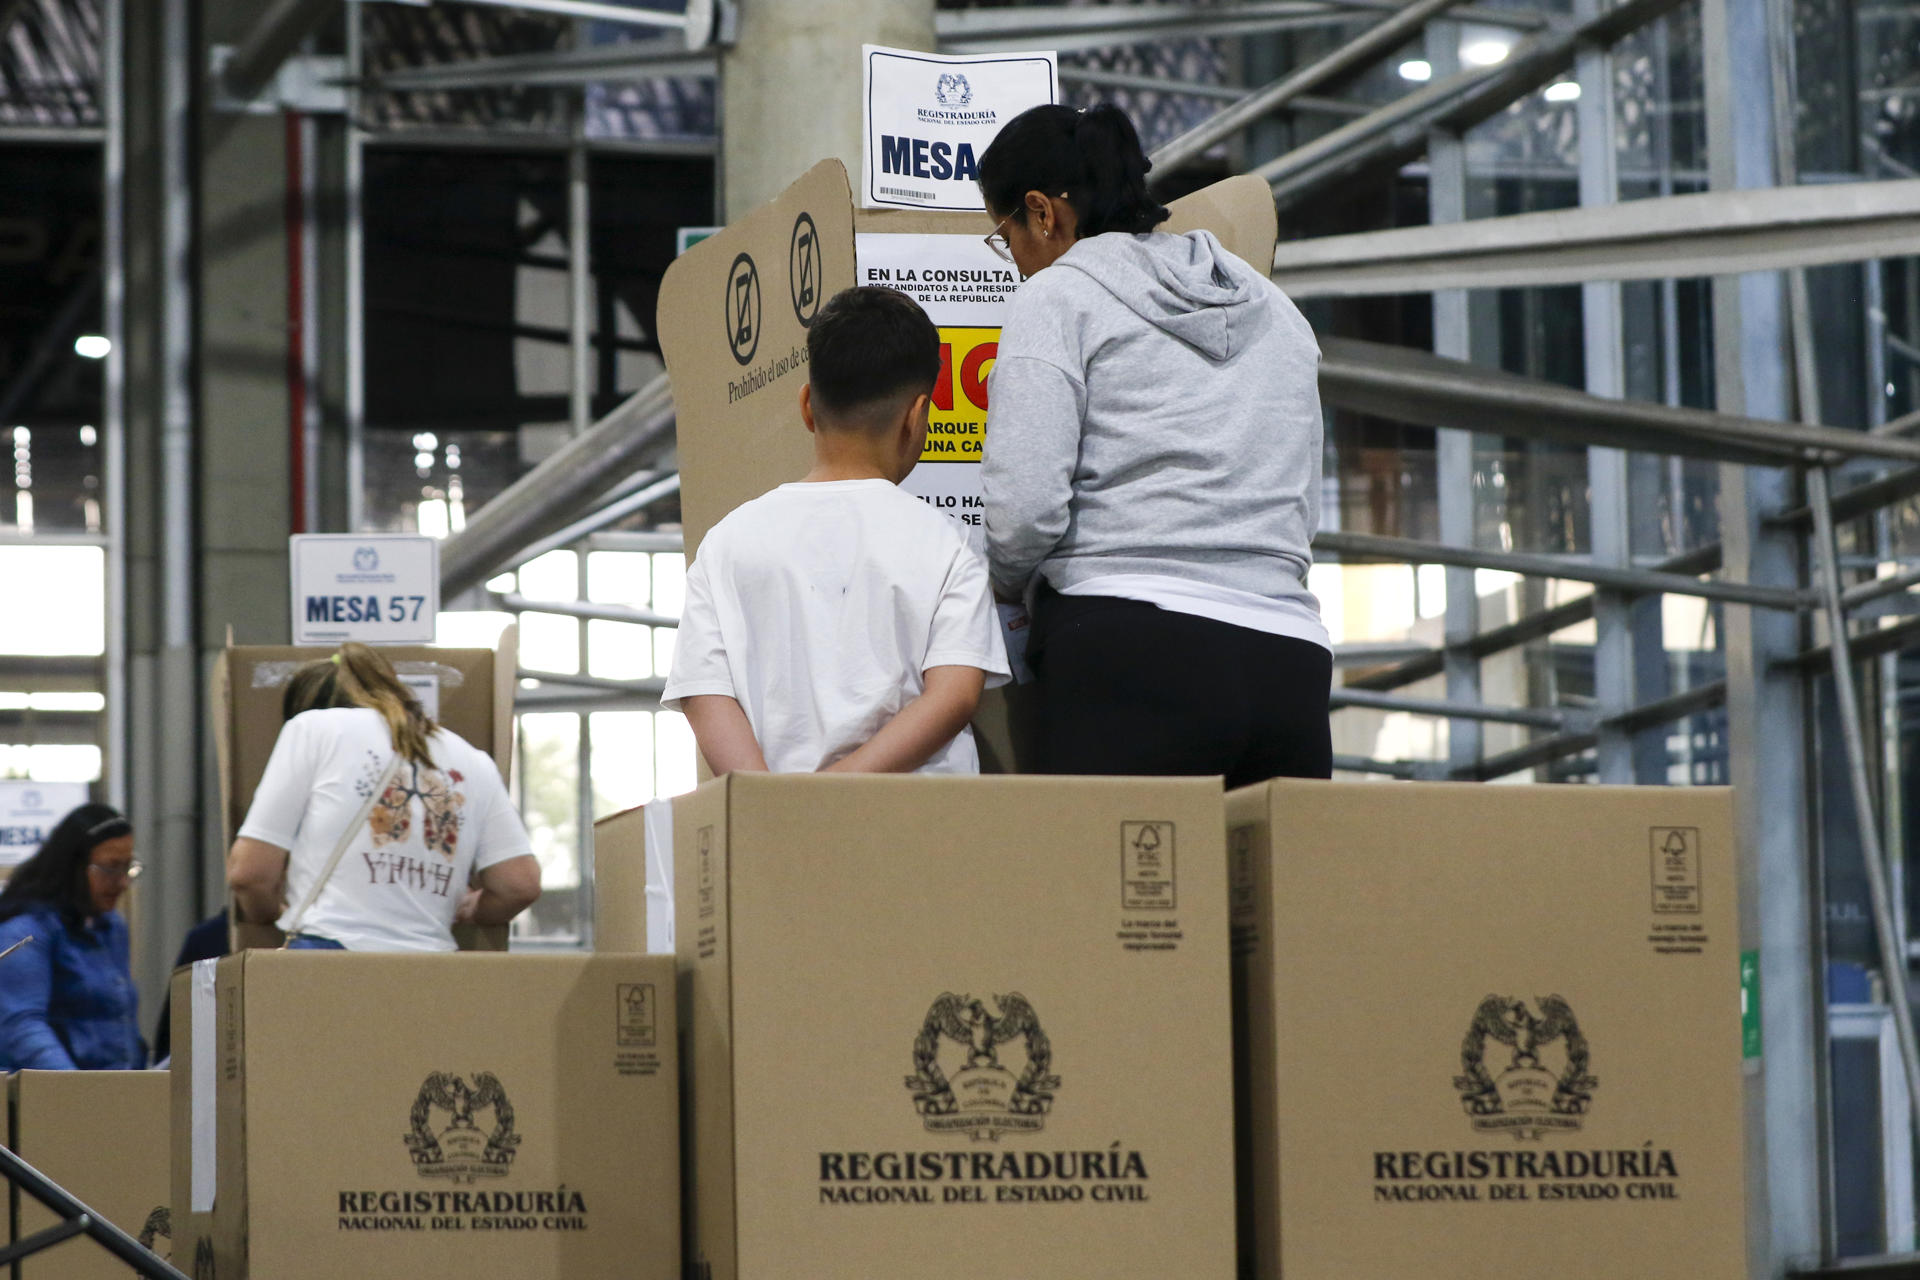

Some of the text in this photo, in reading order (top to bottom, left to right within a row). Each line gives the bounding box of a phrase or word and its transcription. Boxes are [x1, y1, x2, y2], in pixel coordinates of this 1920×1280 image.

[917, 108, 997, 120] REGISTRADURÍA
[881, 135, 978, 181] MESA
[868, 268, 890, 281] EN
[896, 269, 917, 281] LA
[922, 270, 1014, 283] CONSULTA
[976, 285, 1019, 293] PRESIDE
[918, 293, 1005, 303] DE LA REPÚBLICA
[728, 366, 767, 404] Prohibido
[768, 359, 775, 383] el
[776, 357, 788, 378] uso
[790, 346, 799, 369] de
[923, 440, 983, 453] UNA CA
[936, 495, 957, 508] LO
[962, 496, 985, 508] HA
[961, 513, 981, 526] SE
[306, 596, 426, 622] MESA 57
[819, 1140, 1148, 1181] REGISTRADURÍA
[1374, 1140, 1678, 1180] REGISTRADURÍA
[338, 1184, 588, 1214] REGISTRADURÍA
[819, 1184, 1148, 1203] NACIONAL DEL ESTADO CIVIL
[1374, 1182, 1678, 1202] NACIONAL DEL ESTADO CIVIL
[338, 1216, 588, 1231] NACIONAL DEL ESTADO CIVIL
